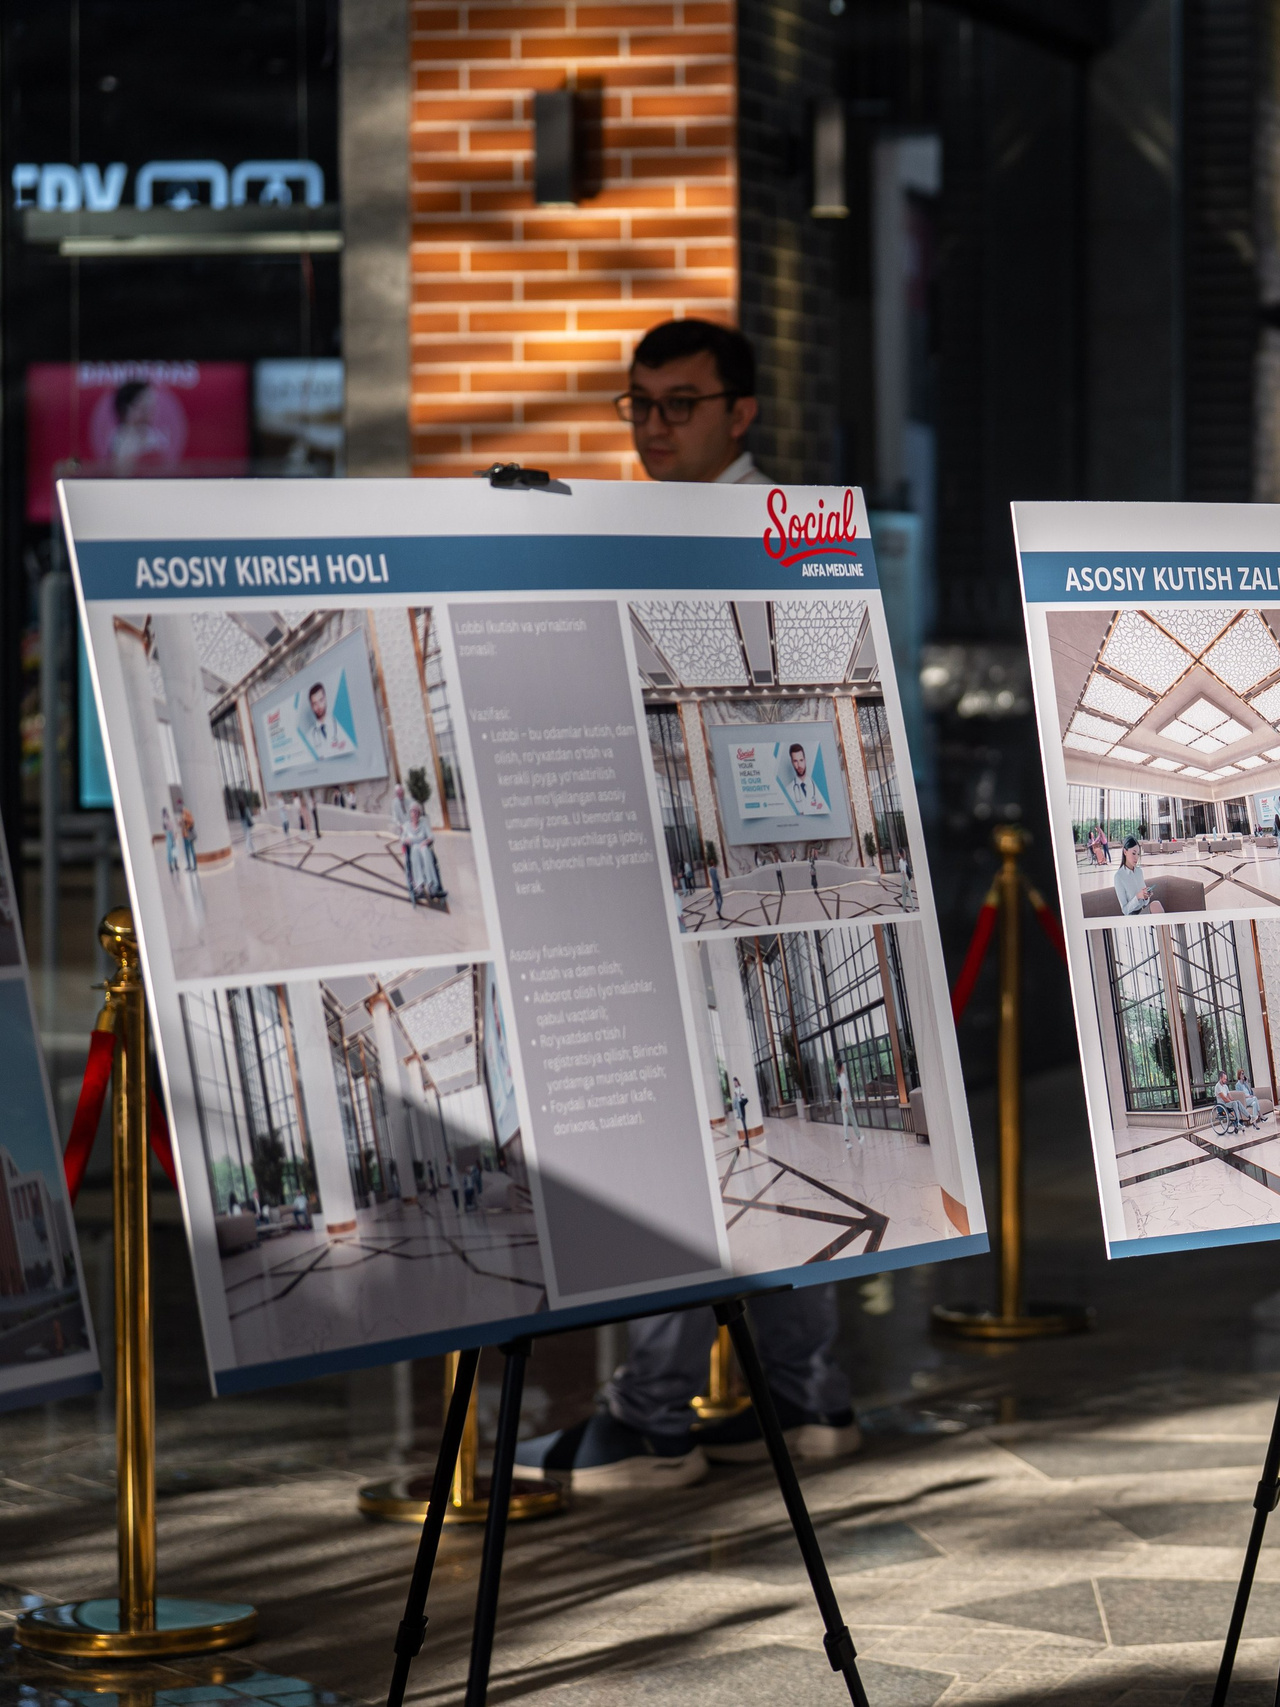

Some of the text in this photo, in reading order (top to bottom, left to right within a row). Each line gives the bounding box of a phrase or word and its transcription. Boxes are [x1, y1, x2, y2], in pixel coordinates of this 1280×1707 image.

[763, 488, 857, 560] Social
[136, 553, 389, 592] ASOSIY KIRISH HOLI
[801, 563, 865, 577] AKFA MEDLINE
[1065, 567, 1146, 592] ASOSIY
[1153, 567, 1233, 591] KUTISH
